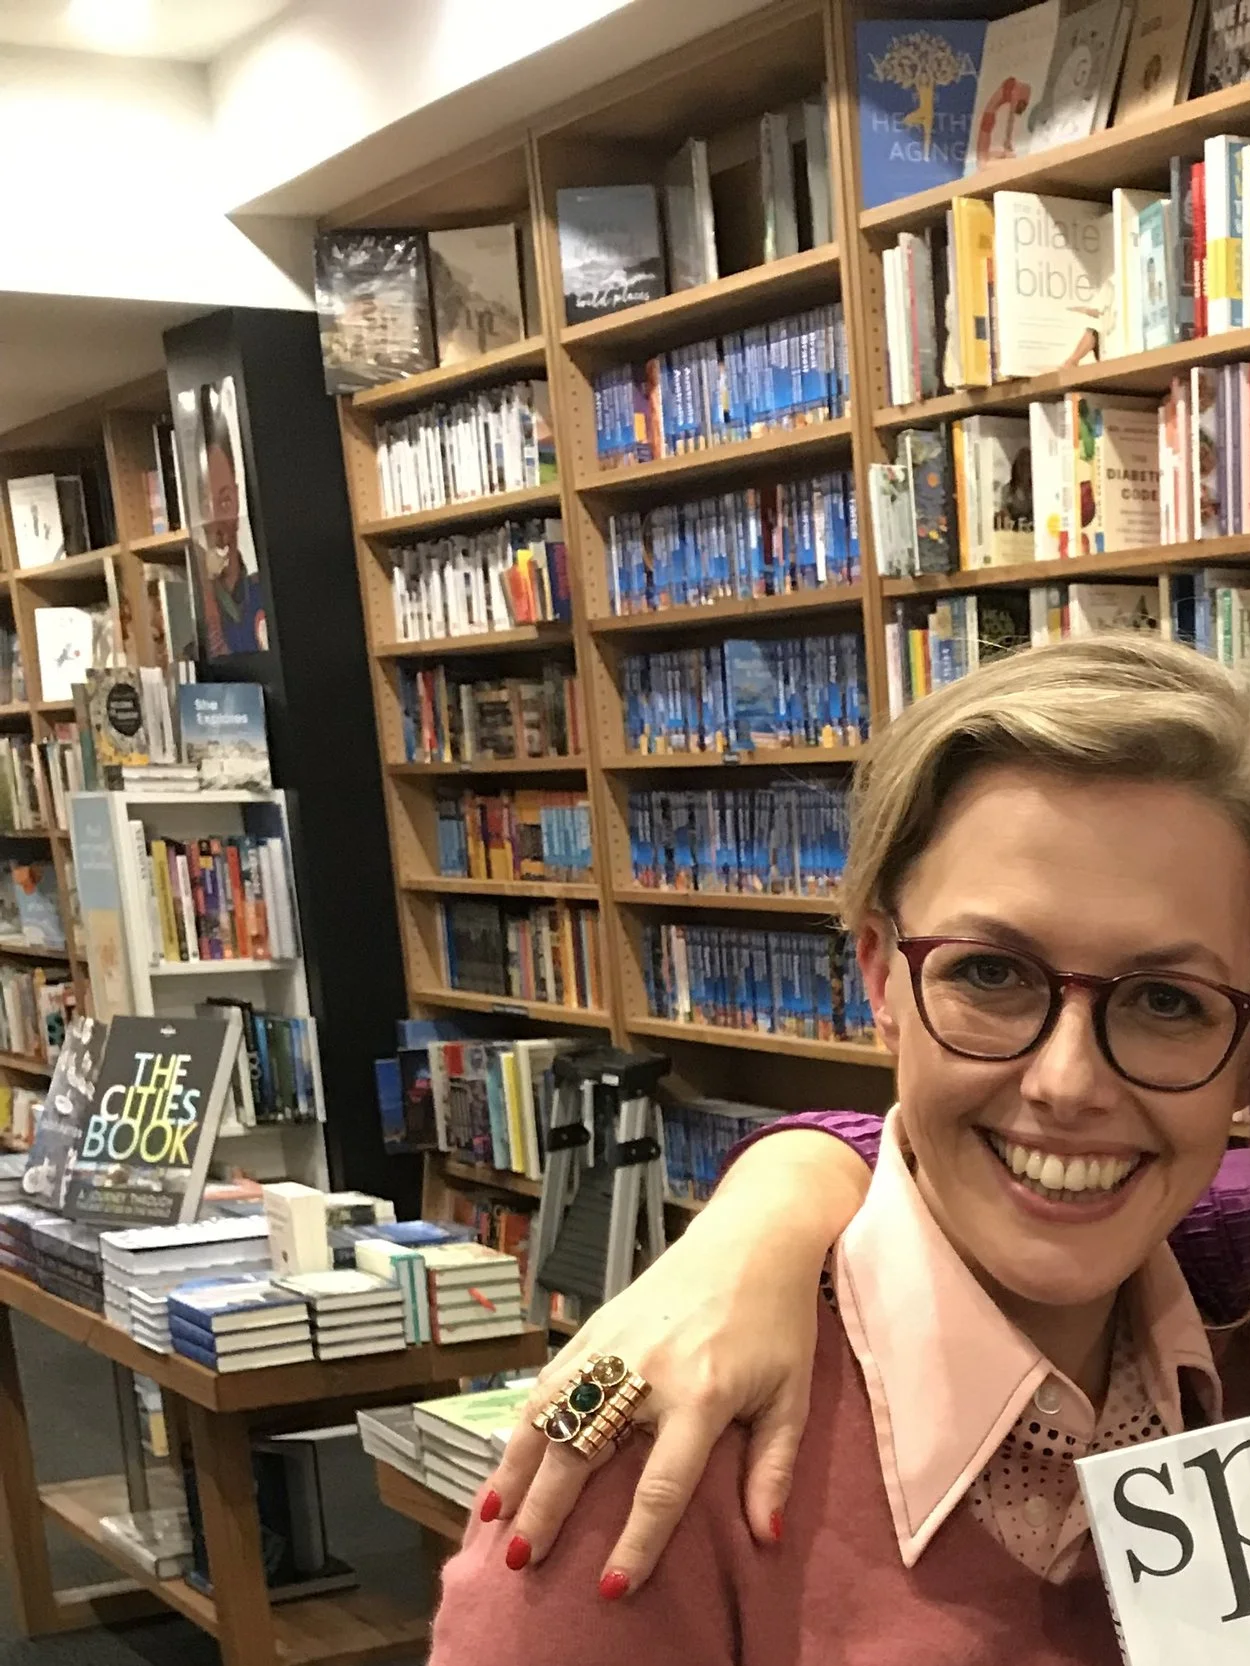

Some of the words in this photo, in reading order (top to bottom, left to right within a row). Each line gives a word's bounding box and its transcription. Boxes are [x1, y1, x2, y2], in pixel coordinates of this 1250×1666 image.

[1014, 215, 1099, 254] pilate
[1015, 261, 1095, 302] bible
[1106, 468, 1163, 482] DIABET
[1121, 488, 1159, 501] CODE
[134, 1052, 191, 1089] THE
[101, 1084, 201, 1126] CITIES
[82, 1114, 198, 1165] BOOK
